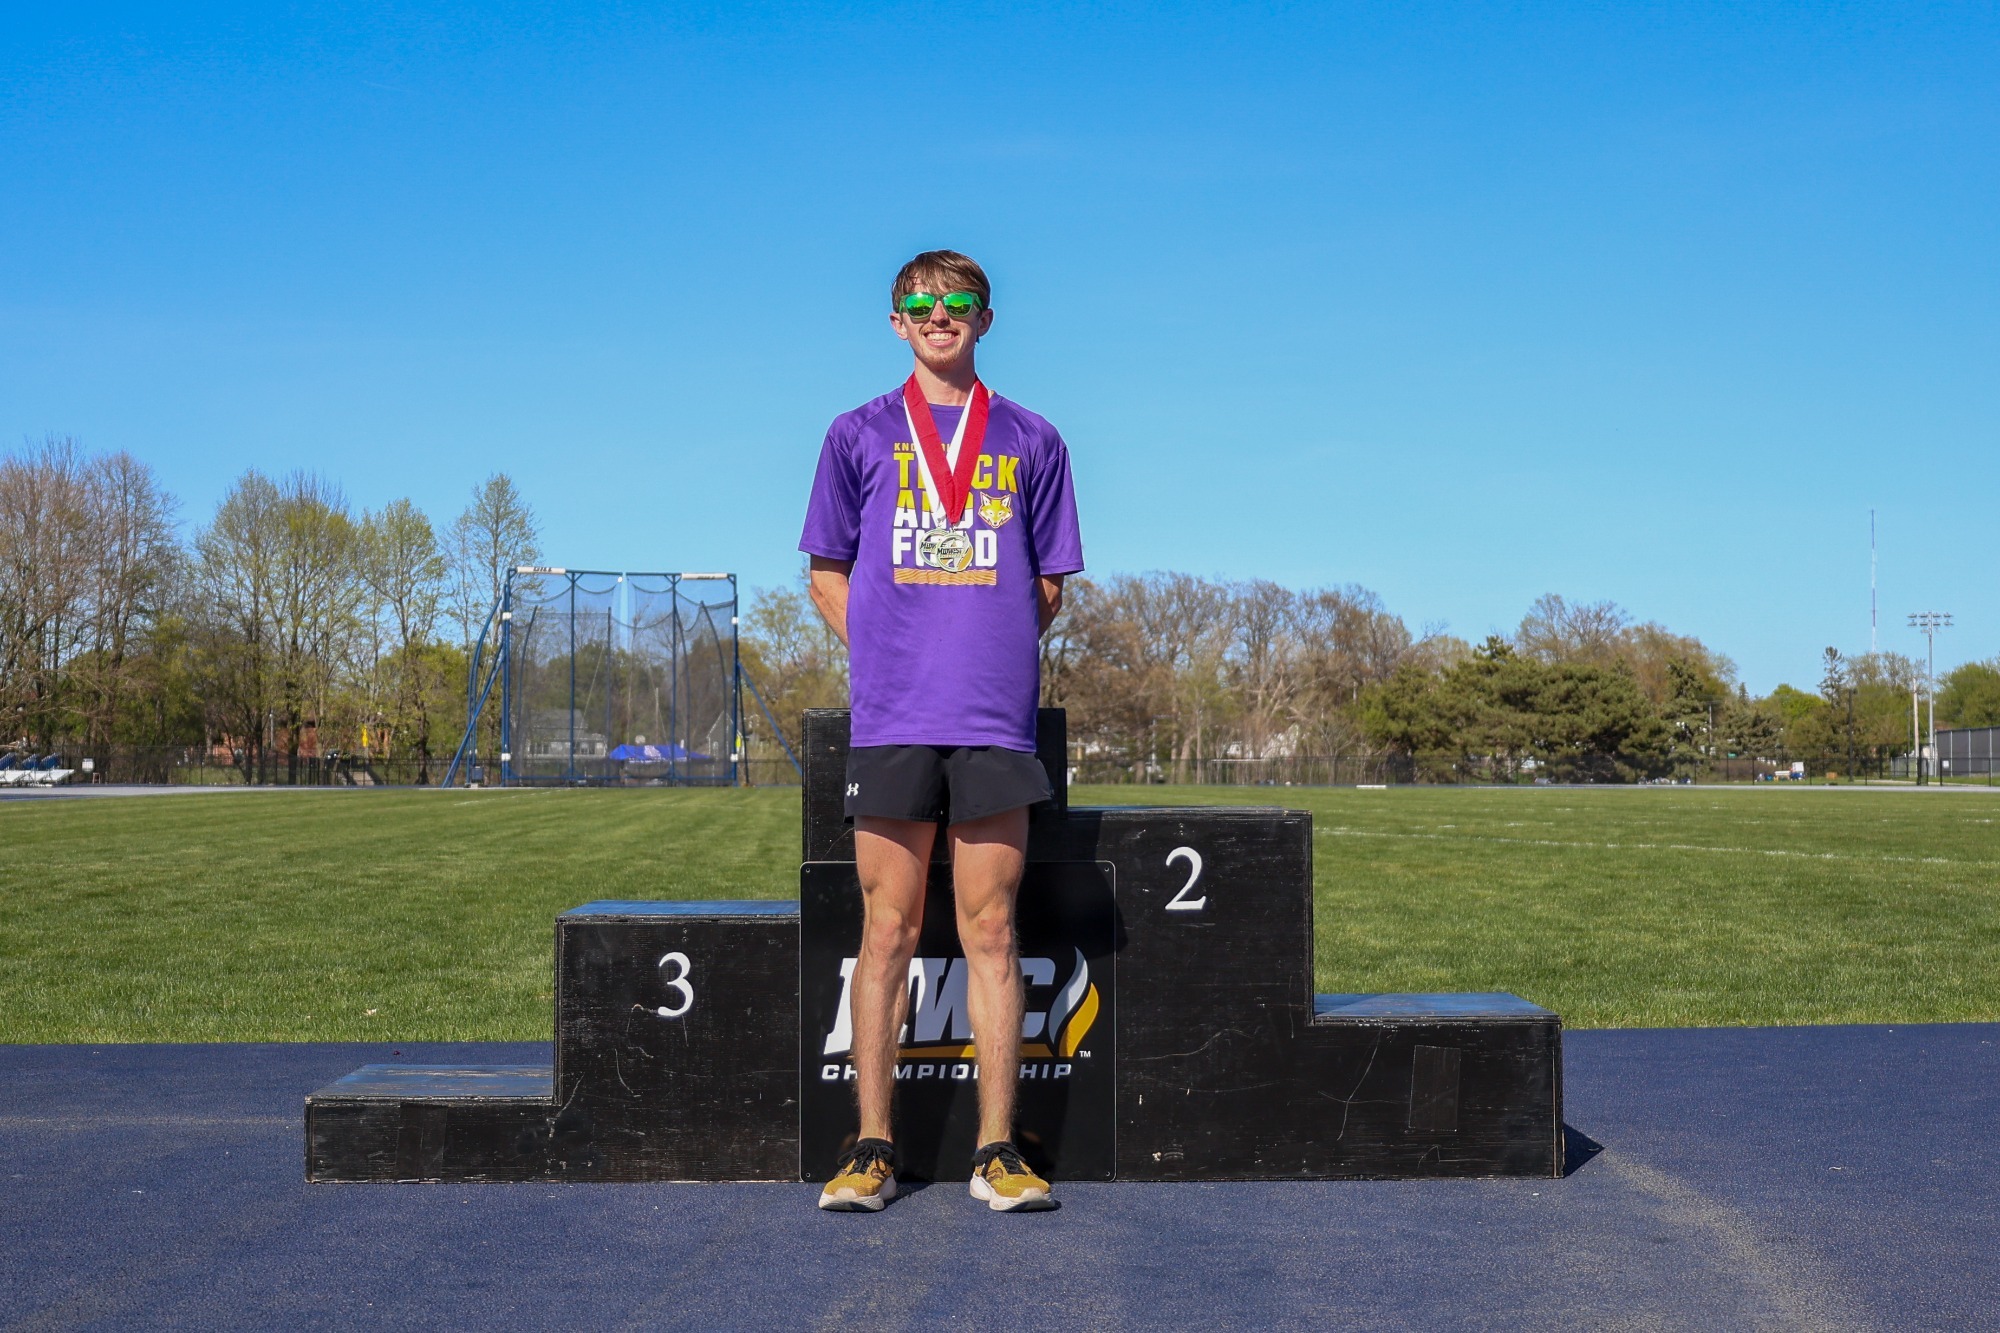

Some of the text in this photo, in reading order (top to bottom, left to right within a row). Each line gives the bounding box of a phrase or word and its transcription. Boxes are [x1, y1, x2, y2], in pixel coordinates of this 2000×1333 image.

[893, 452, 1020, 494] TCK
[1165, 846, 1207, 911] 2
[658, 952, 695, 1017] 3
[821, 1063, 1072, 1081] CHMPIOHIP
[1079, 1050, 1091, 1058] TM
